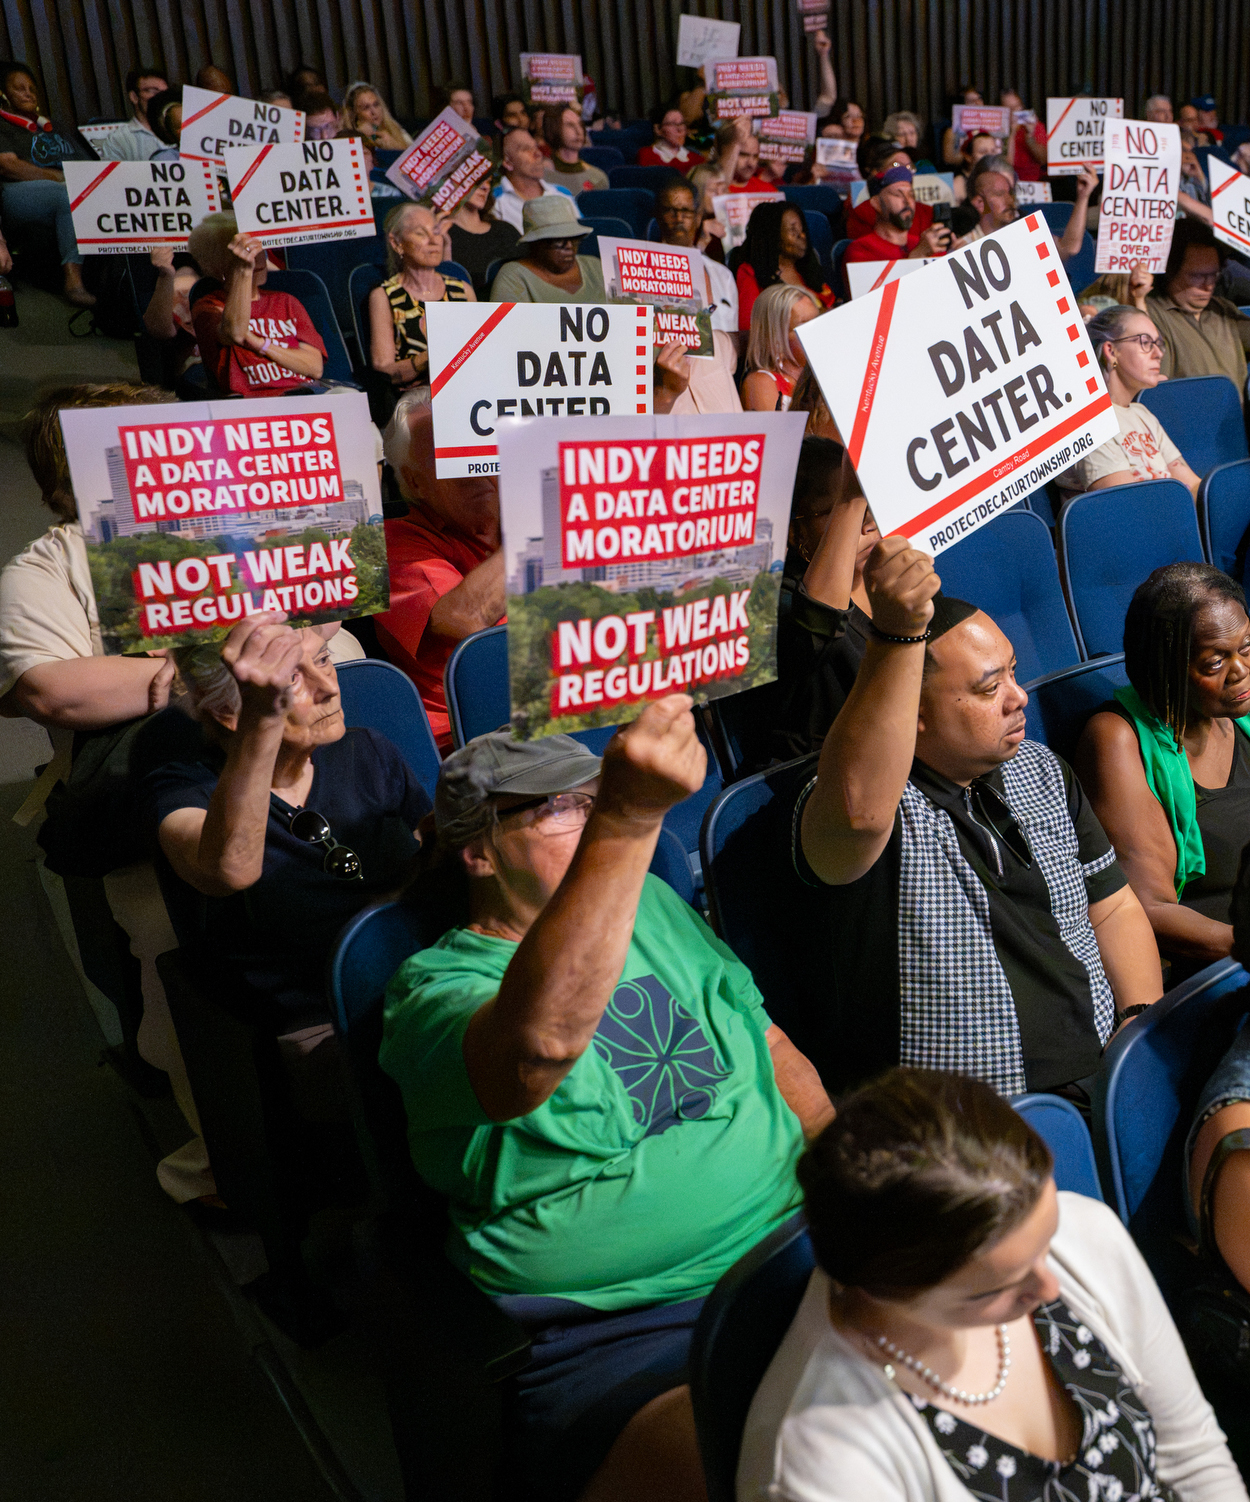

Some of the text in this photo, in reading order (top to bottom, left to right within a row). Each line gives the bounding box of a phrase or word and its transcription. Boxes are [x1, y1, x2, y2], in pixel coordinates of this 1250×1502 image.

[254, 103, 281, 124] NO
[1090, 100, 1108, 115] NO
[229, 118, 280, 143] DATA
[400, 122, 451, 175] INDY NEEDS
[1126, 126, 1158, 156] NO
[302, 141, 334, 164] NO
[150, 163, 186, 182] NO
[280, 167, 340, 193] DATA
[431, 149, 485, 207] NOT WEAK
[1109, 163, 1169, 194] DATA
[124, 187, 191, 207] DATA
[255, 196, 351, 224] CENTER.
[1101, 196, 1175, 219] CENTERS
[1109, 222, 1164, 243] PEOPLE
[1121, 243, 1151, 256] OVER
[618, 249, 689, 270] INDY NEEDS
[622, 266, 690, 283] A DATA CENTER
[947, 238, 1011, 310] NO
[623, 278, 692, 297] MORATORIUM
[560, 306, 610, 342] NO
[652, 331, 701, 347] ULATIONS
[657, 313, 700, 332] WEAK
[450, 331, 485, 370] Kentucky Avenue
[927, 300, 1042, 398] DATA
[517, 351, 612, 387] DATA
[861, 335, 885, 413] Kentucky Avenue
[125, 417, 332, 460] INDY NEEDS
[906, 364, 1073, 491] CENTER.
[135, 450, 335, 487] A DATA CENTER
[563, 440, 761, 486] INDY NEEDS
[993, 448, 1030, 478] Camby Road
[135, 475, 340, 518] MORATORIUM
[566, 480, 755, 522] A DATA CENTER
[929, 432, 1094, 551] PROTECTDECATURTOWNSHIP.ORG
[566, 511, 754, 562] MORATORIUM
[137, 537, 356, 598] NOT WEAK
[145, 576, 360, 629] REGULATIONS
[558, 589, 751, 667] NOT WEAK
[558, 635, 750, 708] REGULATIONS
